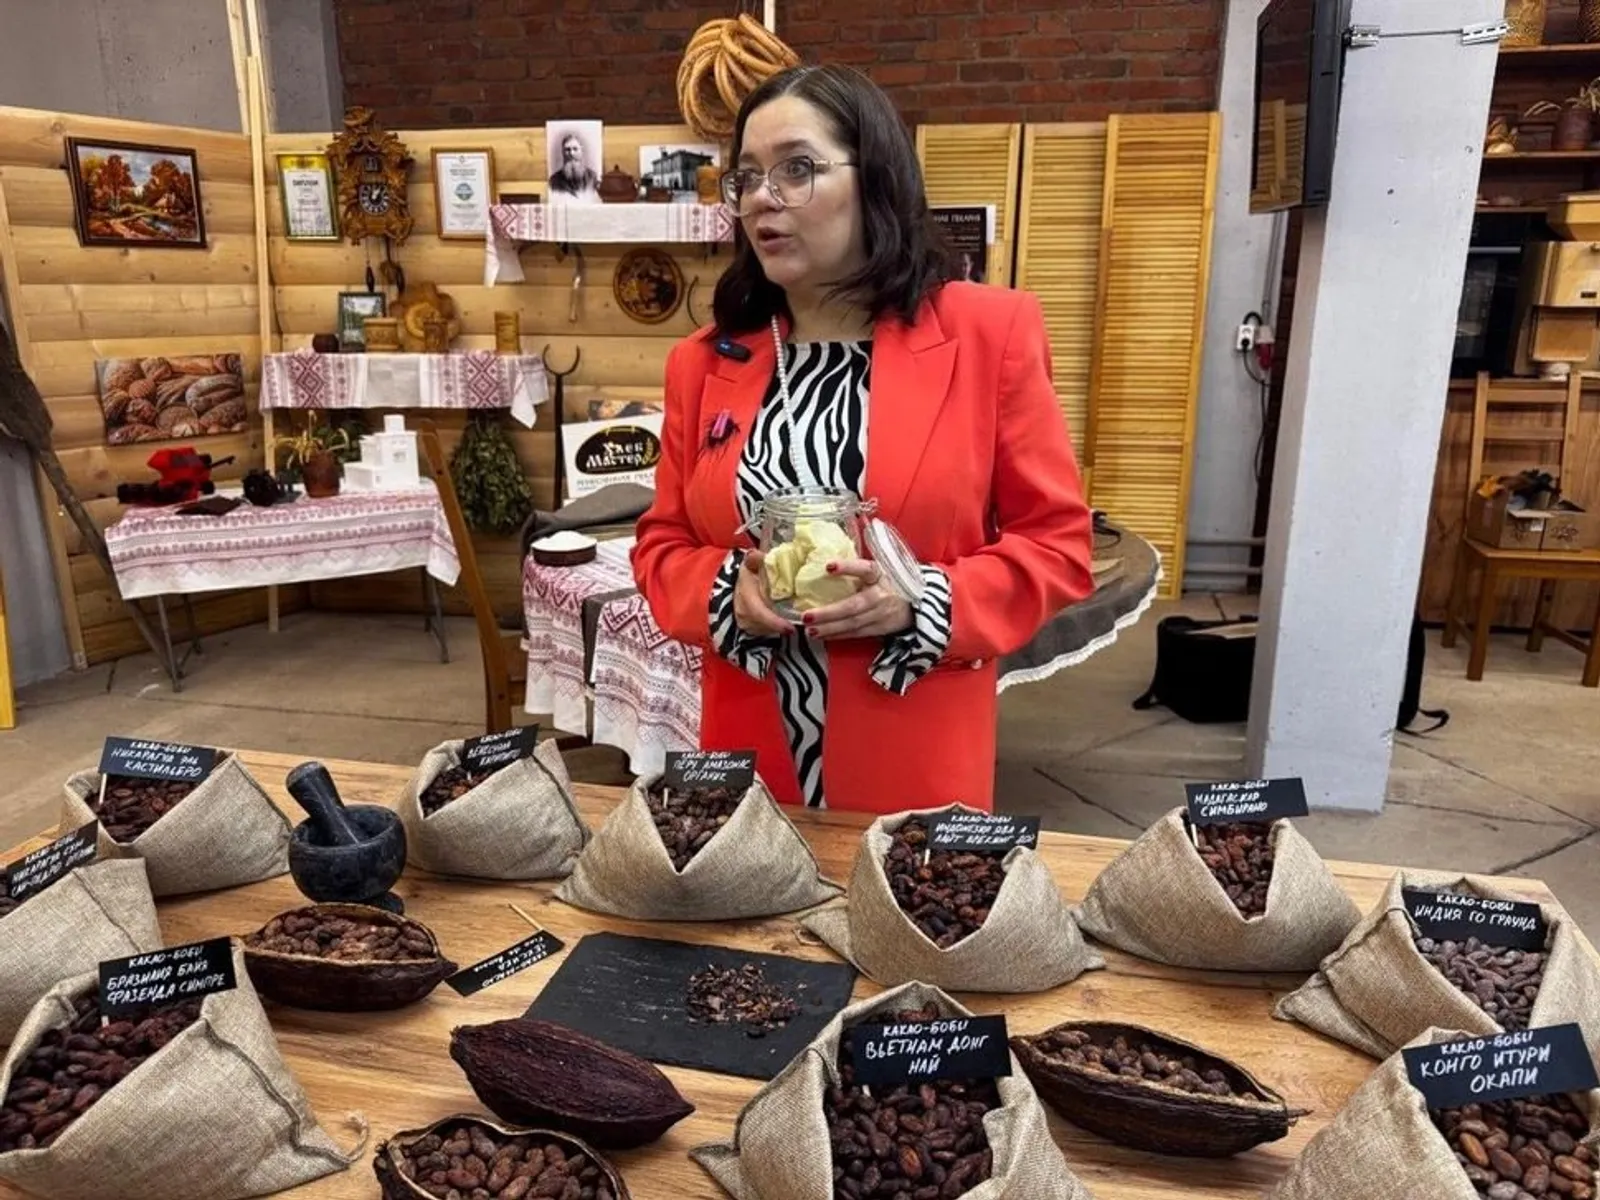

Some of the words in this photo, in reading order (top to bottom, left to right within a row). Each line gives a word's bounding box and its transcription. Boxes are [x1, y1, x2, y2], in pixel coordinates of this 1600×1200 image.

[110, 748, 174, 763] НИКАРАГУА
[1194, 792, 1260, 805] МАДАГАСКАР
[1436, 894, 1515, 911] КАКАО-БОБЫ
[1414, 904, 1463, 922] ИНДИЯ
[1469, 910, 1486, 923] ГО
[1490, 912, 1537, 932] ГРАУНД
[128, 945, 205, 968] КАКАО-БОБЫ
[106, 965, 174, 990] БРАЗИЛИЯ
[107, 982, 177, 1005] ФАЗЕНДА
[883, 1020, 969, 1037] КАКАО-БОБЫ
[865, 1038, 943, 1060] ВЬЕТНАМ
[947, 1035, 990, 1055] ДОНГ
[1440, 1031, 1534, 1054] КАКАО-БОБЫ
[908, 1054, 942, 1075] НАЙ
[1420, 1054, 1482, 1077] КОНГО
[1494, 1043, 1551, 1068] ИТУРИ
[1470, 1066, 1539, 1093] ОКАПИ
